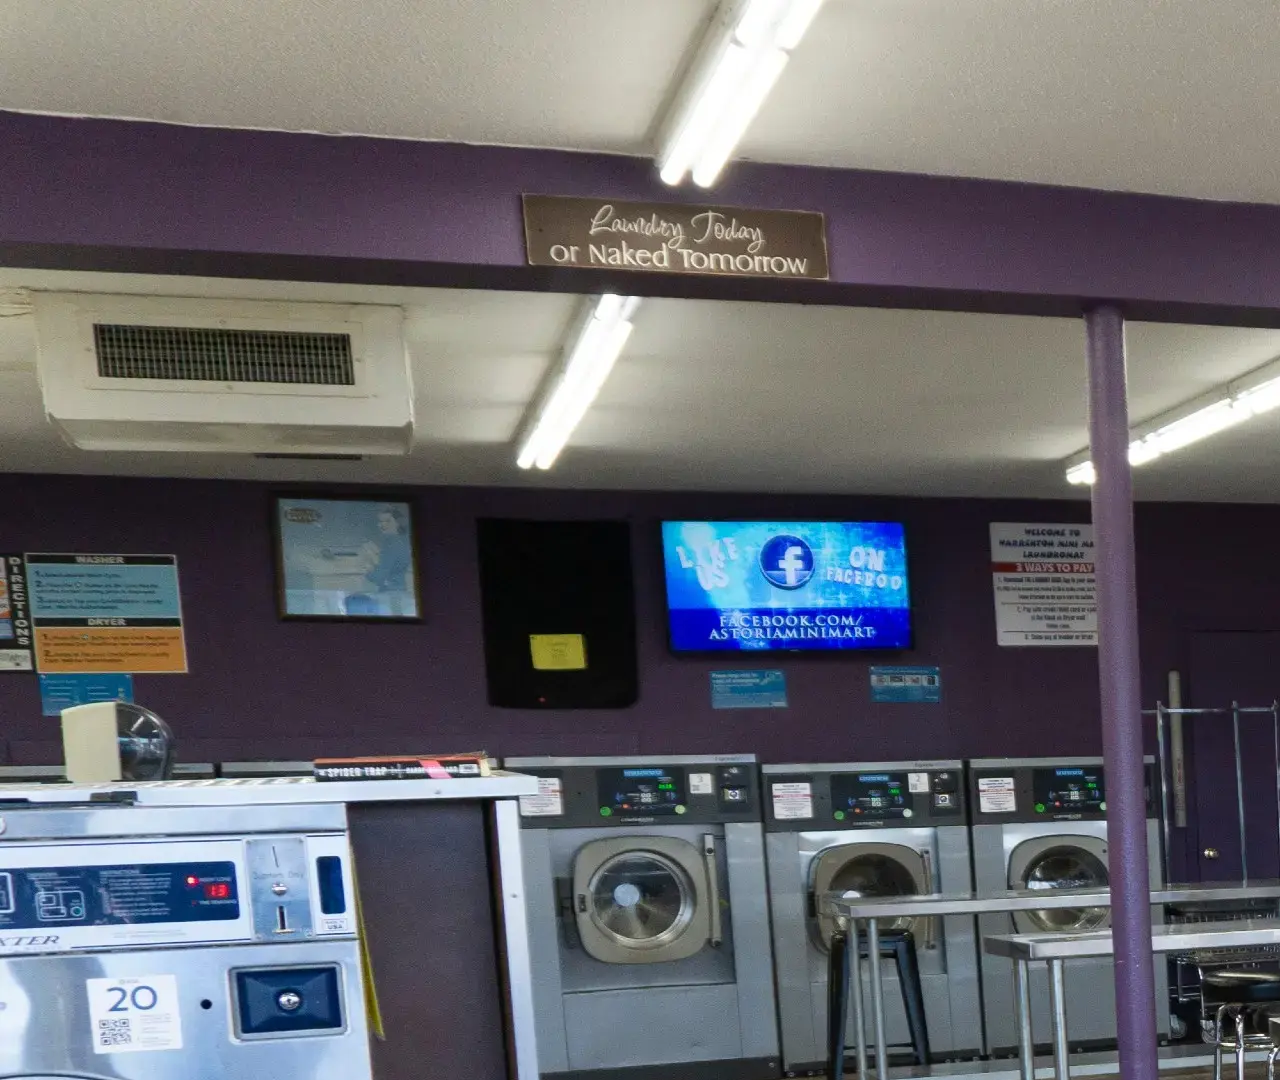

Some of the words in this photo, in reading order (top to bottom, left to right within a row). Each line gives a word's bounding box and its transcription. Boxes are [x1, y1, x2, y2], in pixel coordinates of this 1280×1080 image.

[588, 204, 686, 249] Laundry
[690, 210, 766, 254] Today
[549, 243, 578, 264] or
[589, 240, 669, 268] Naked
[677, 248, 807, 275] Tomorrow
[1024, 528, 1066, 537] WELCOME
[1068, 529, 1081, 537] TO
[998, 540, 1055, 548] WARRENTON
[75, 556, 125, 564] WASHER
[849, 546, 886, 572] ON
[1015, 563, 1023, 572] 3
[1024, 563, 1055, 573] WAYS
[1056, 564, 1071, 573] TO
[1072, 564, 1094, 573] PAY
[696, 564, 731, 591] US
[8, 556, 30, 646] DIRECTIONS
[87, 618, 127, 626] DRYER
[719, 614, 864, 628] FACEBOOK.COM/
[708, 626, 875, 640] ASTORIAMINIMART
[327, 767, 363, 778] SPIDER
[364, 766, 388, 777] TRAP
[106, 984, 159, 1013] 20
